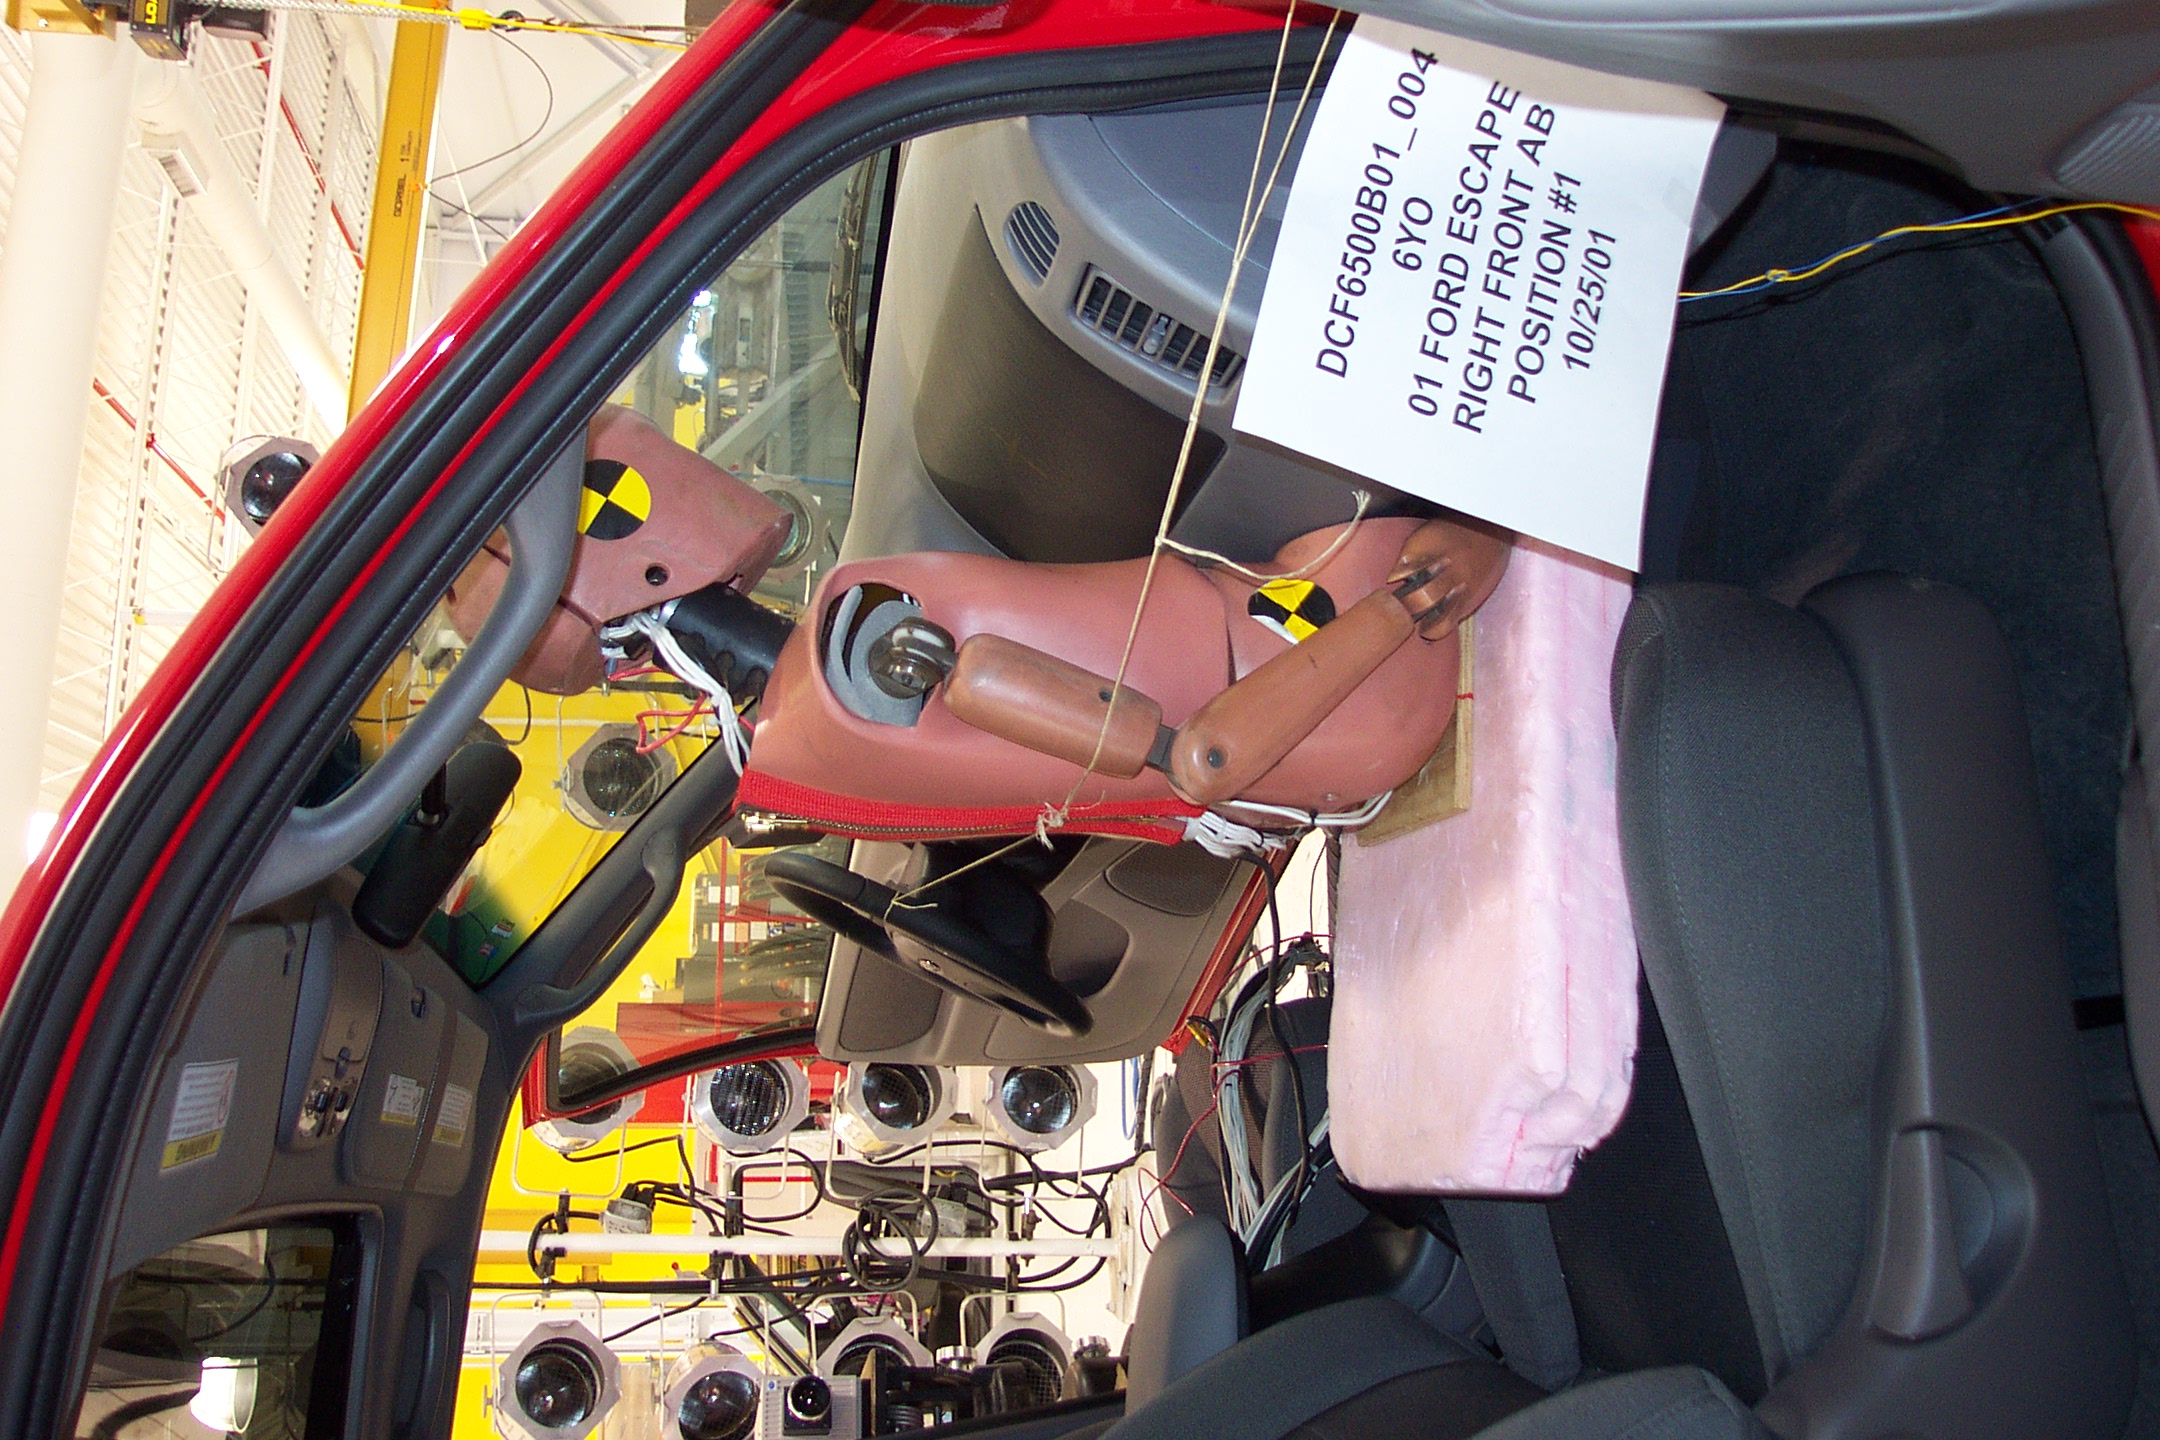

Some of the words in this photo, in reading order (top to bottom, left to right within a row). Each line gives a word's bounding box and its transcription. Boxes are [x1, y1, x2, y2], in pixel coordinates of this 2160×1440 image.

[1316, 47, 1438, 378] DCF6500B01_004
[1392, 197, 1433, 271] 6YO
[1446, 80, 1522, 245] ESCAPE
[1419, 253, 1469, 363] FORD
[1453, 306, 1505, 433] RIGHT
[1482, 169, 1533, 301] FRONT
[1516, 104, 1556, 167] AB
[1507, 219, 1572, 403] POSITION
[1548, 172, 1581, 214] #1
[1562, 229, 1616, 369] 10/25/01
[1408, 374, 1443, 416] 01
